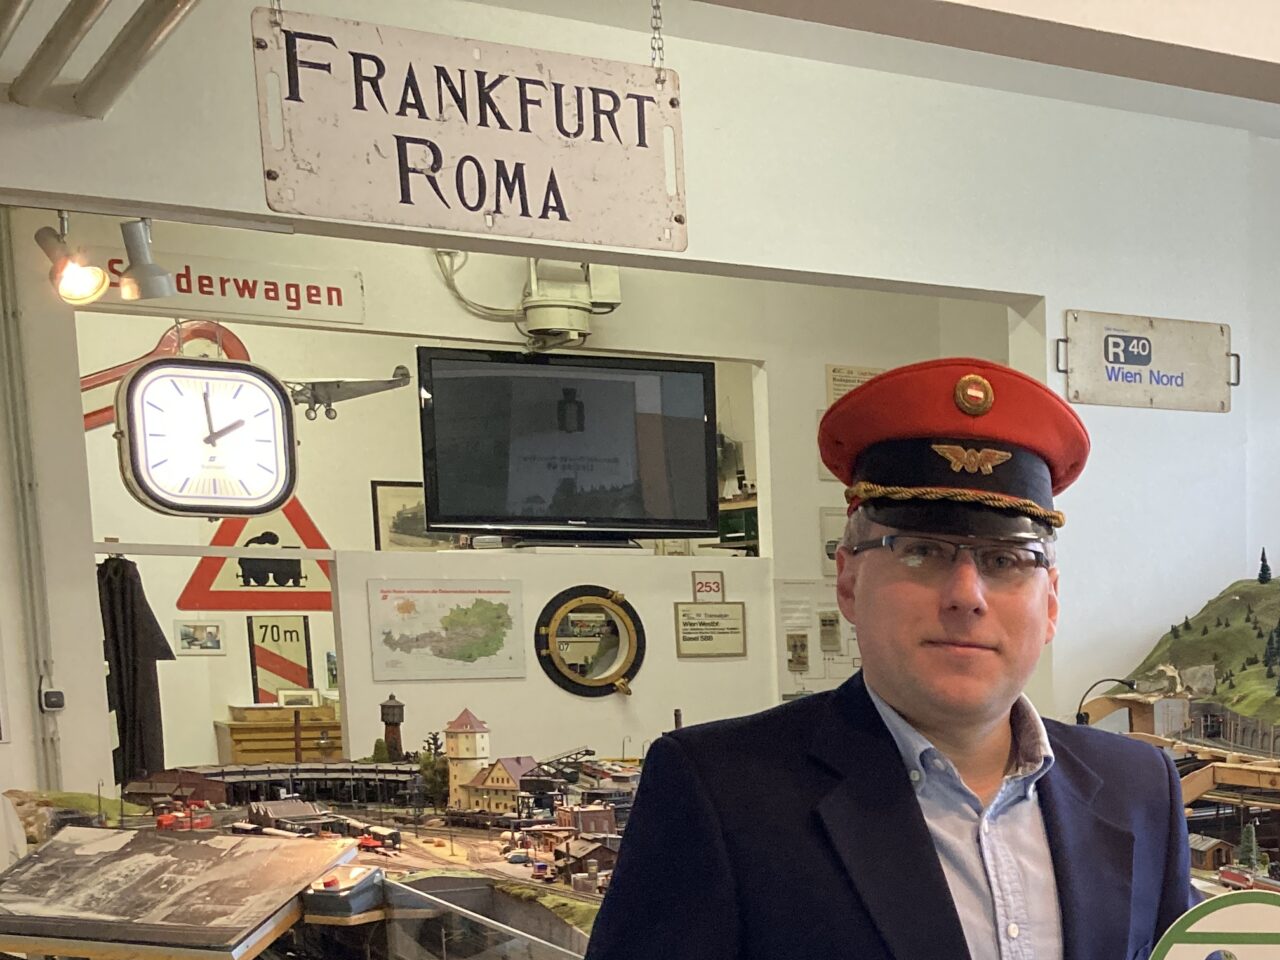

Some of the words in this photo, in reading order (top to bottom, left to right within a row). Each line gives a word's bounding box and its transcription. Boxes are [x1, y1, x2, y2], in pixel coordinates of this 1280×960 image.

[282, 29, 657, 149] FRANKFURT
[392, 134, 571, 223] ROMA
[107, 258, 343, 311] Sderwagen
[1105, 365, 1143, 384] Wien
[1149, 370, 1184, 388] Nord
[696, 581, 721, 593] 253
